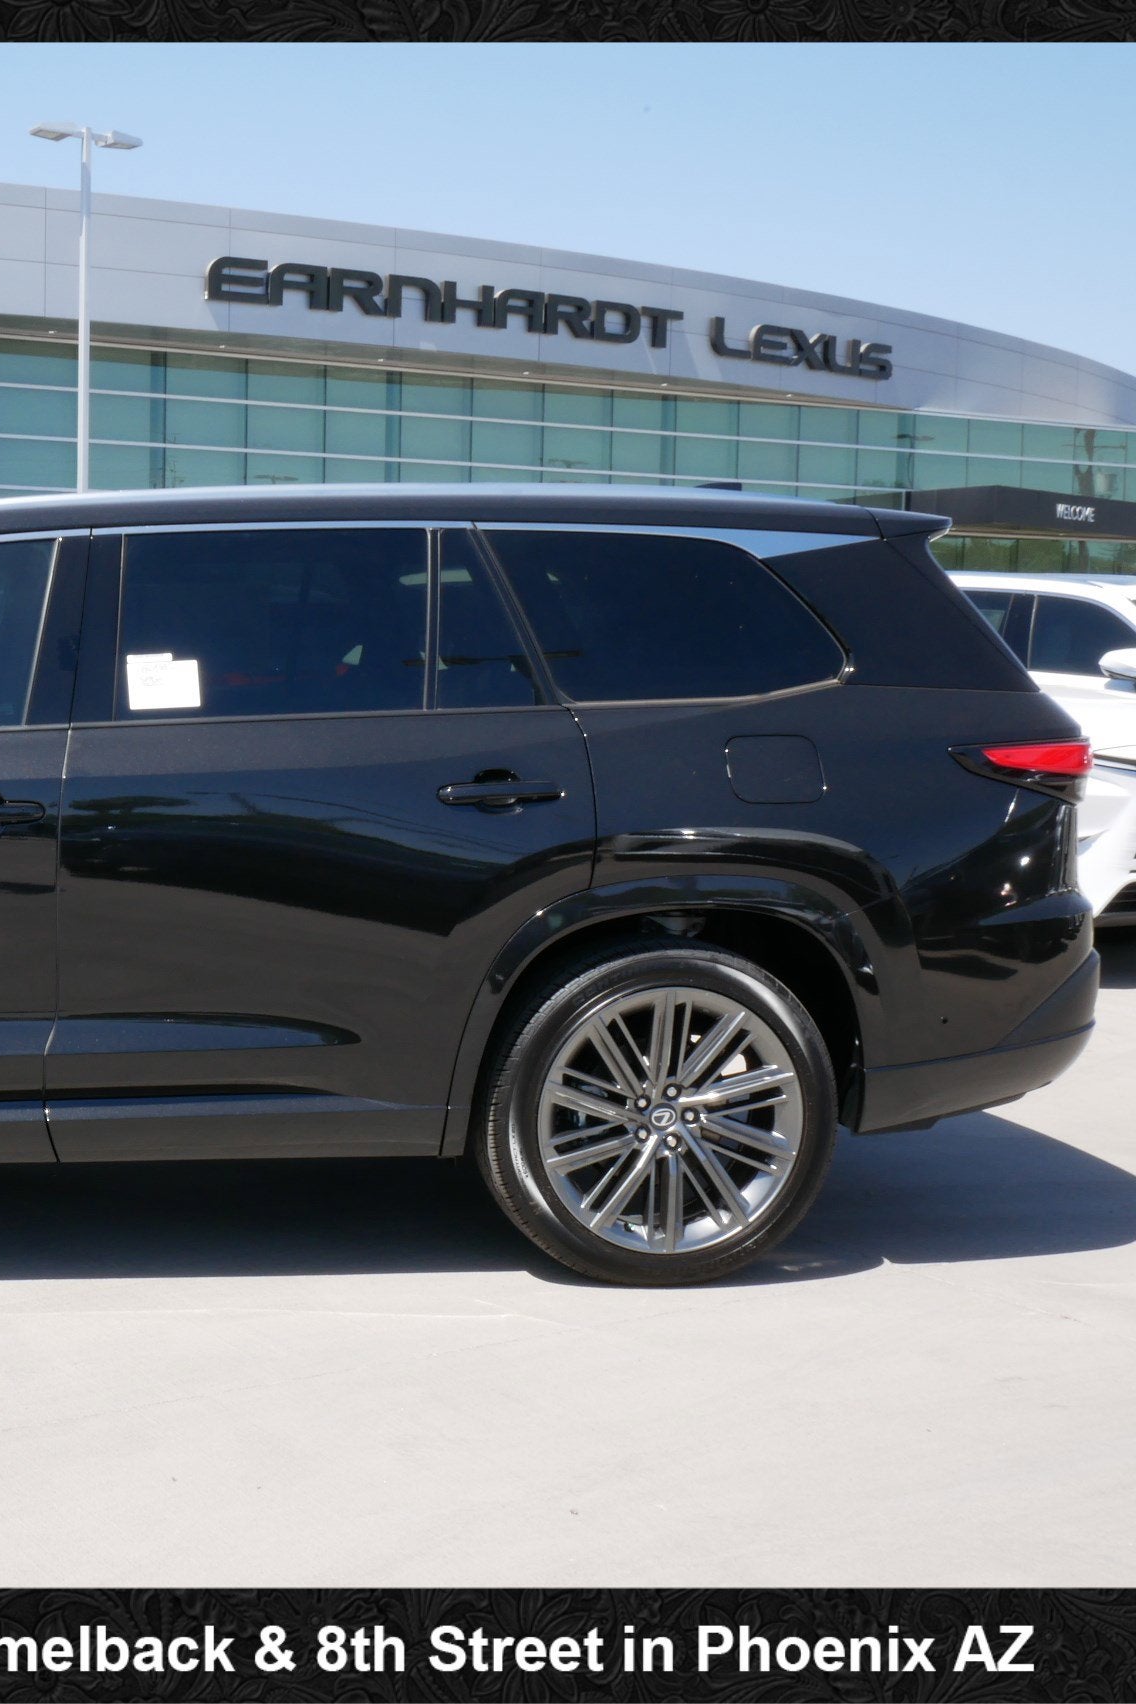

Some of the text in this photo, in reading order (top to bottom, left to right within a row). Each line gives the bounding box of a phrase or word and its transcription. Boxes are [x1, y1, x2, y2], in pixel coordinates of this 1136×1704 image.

[205, 256, 892, 380] EARNHARDT LEXUS
[1056, 503, 1096, 523] WELCOME
